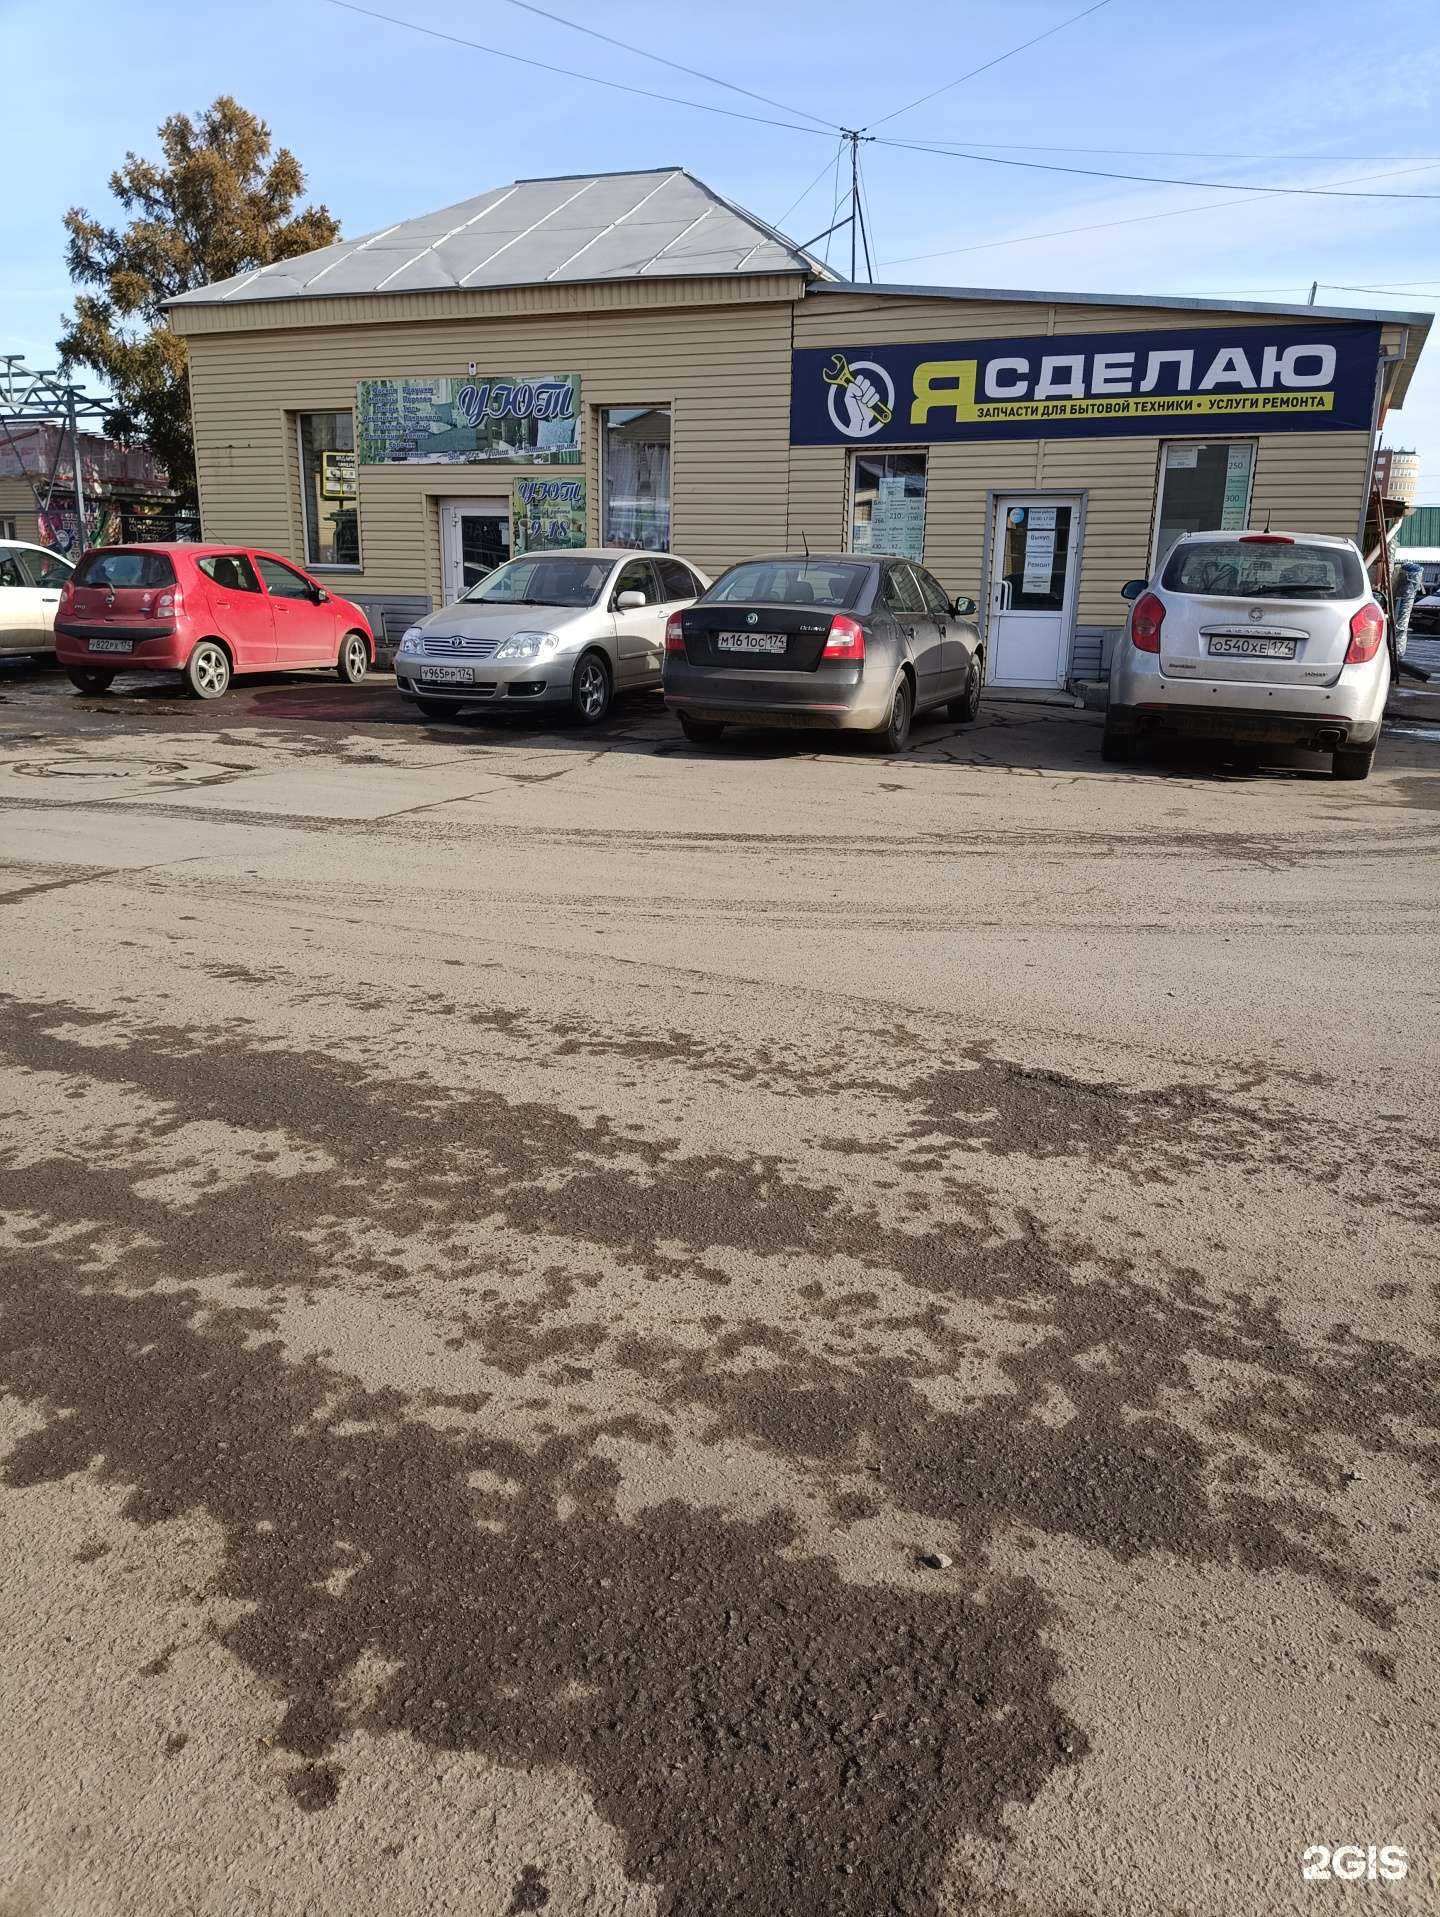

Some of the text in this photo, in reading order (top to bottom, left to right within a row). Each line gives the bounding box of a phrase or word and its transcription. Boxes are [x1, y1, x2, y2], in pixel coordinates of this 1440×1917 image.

[909, 344, 1337, 424] Я СДЕЛАЮ
[976, 396, 1326, 419] ЗАПЧАСТИ ДЛЯ БЫТОВОЙ ТЕХНИКИ УСЛУГИ РЕМОНТА
